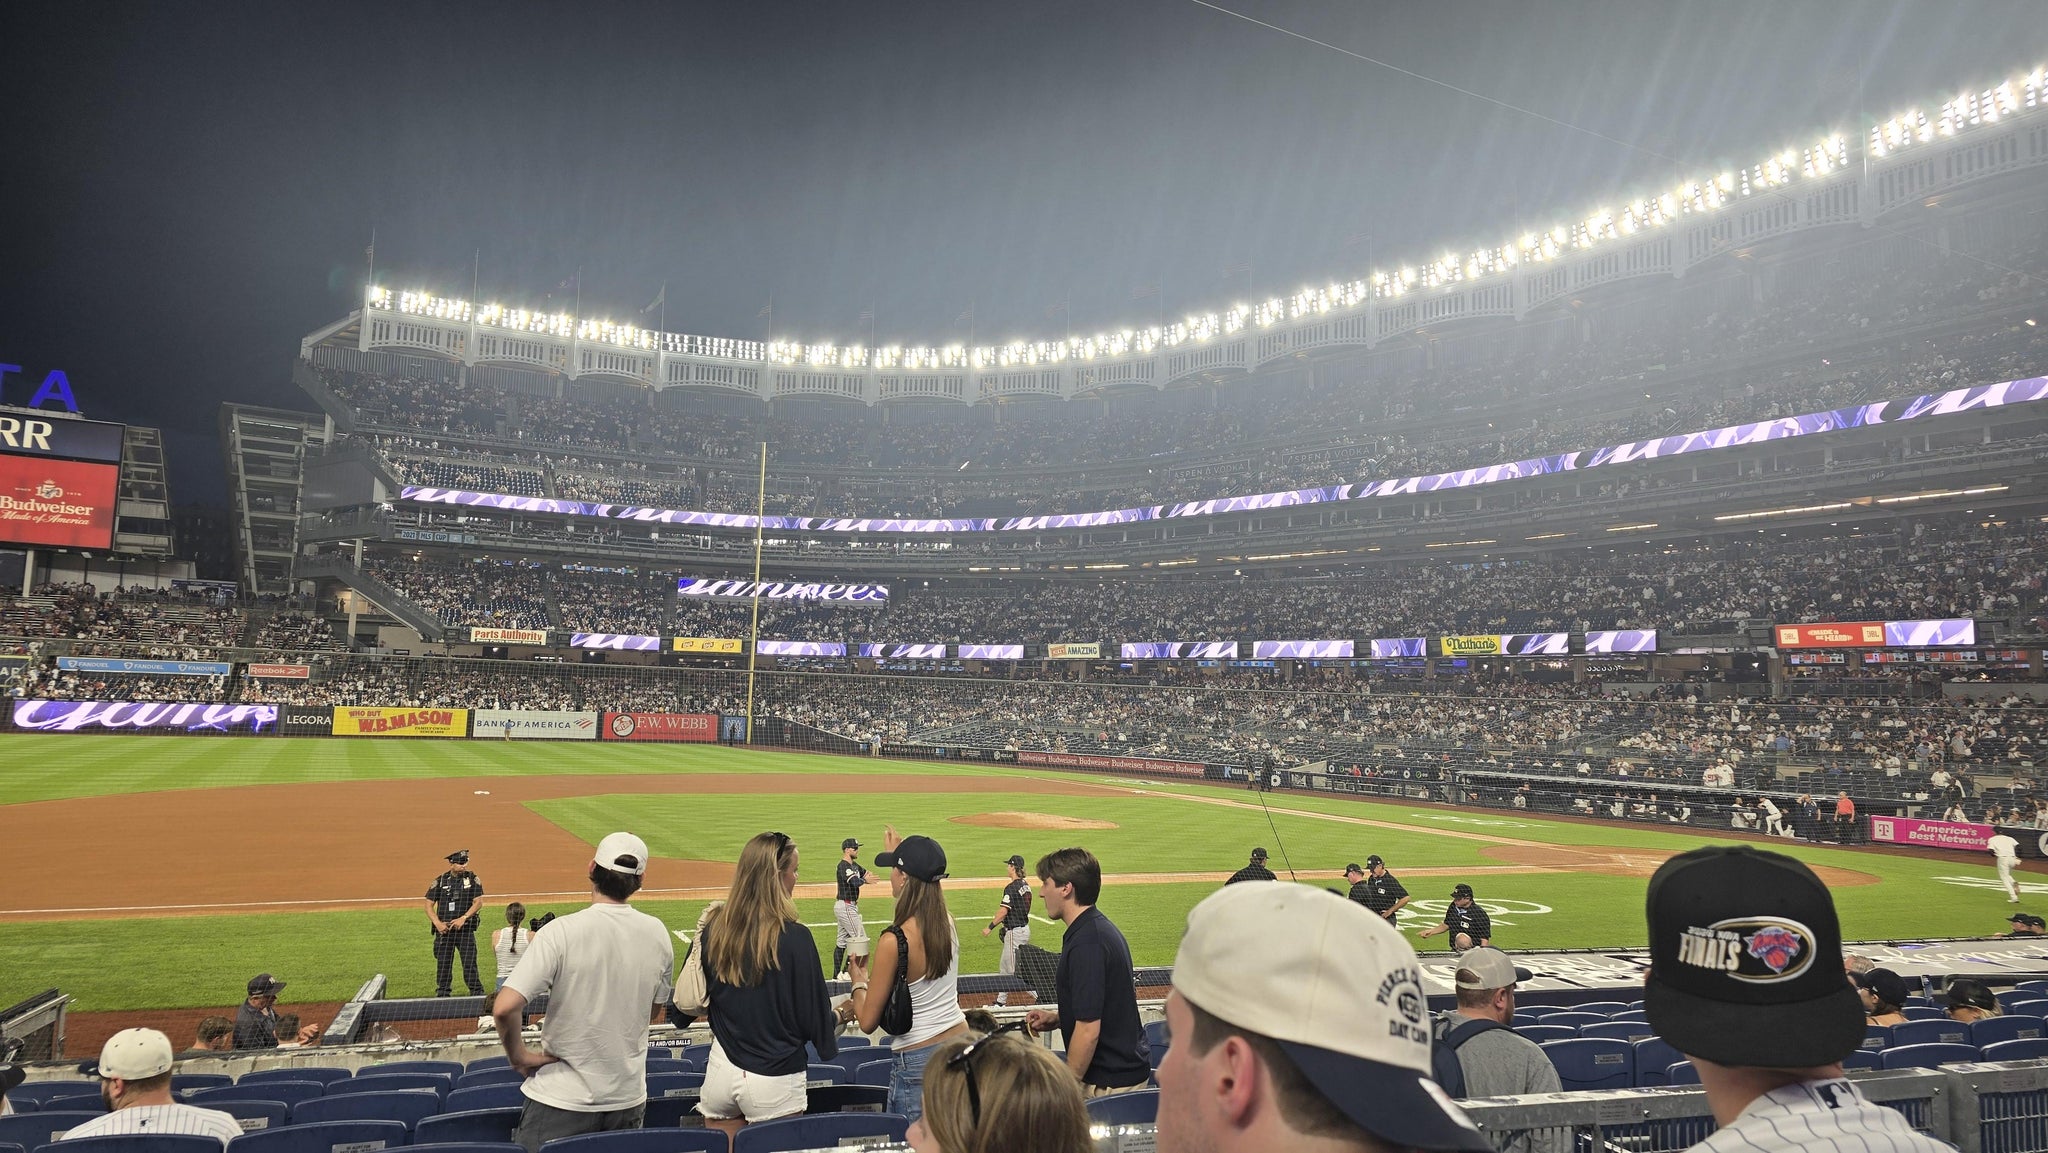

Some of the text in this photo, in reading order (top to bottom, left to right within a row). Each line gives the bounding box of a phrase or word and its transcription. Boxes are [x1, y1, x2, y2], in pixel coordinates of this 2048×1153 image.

[0, 495, 94, 515] Budweiser
[474, 630, 543, 641] Parts Authority
[1446, 637, 1498, 650] Nathan's
[1067, 647, 1098, 655] AMAZING
[287, 715, 331, 725] LEGORA
[524, 721, 571, 729] AMERICA
[637, 716, 661, 729] F.W.
[666, 717, 708, 729] WEBB
[1018, 753, 1046, 762] Budweiser
[1048, 756, 1077, 764] Budweiser
[1079, 757, 1110, 766] Budweiser
[1112, 759, 1143, 768] Budweiser
[1145, 761, 1174, 771] Budweiser
[1175, 764, 1205, 774] Budweiser
[1918, 823, 1978, 836] America's
[1909, 831, 1988, 846] Best Network
[1679, 933, 1742, 971] FINALS
[1376, 968, 1408, 1006] PIERCE
[1389, 1020, 1409, 1039] DAY
